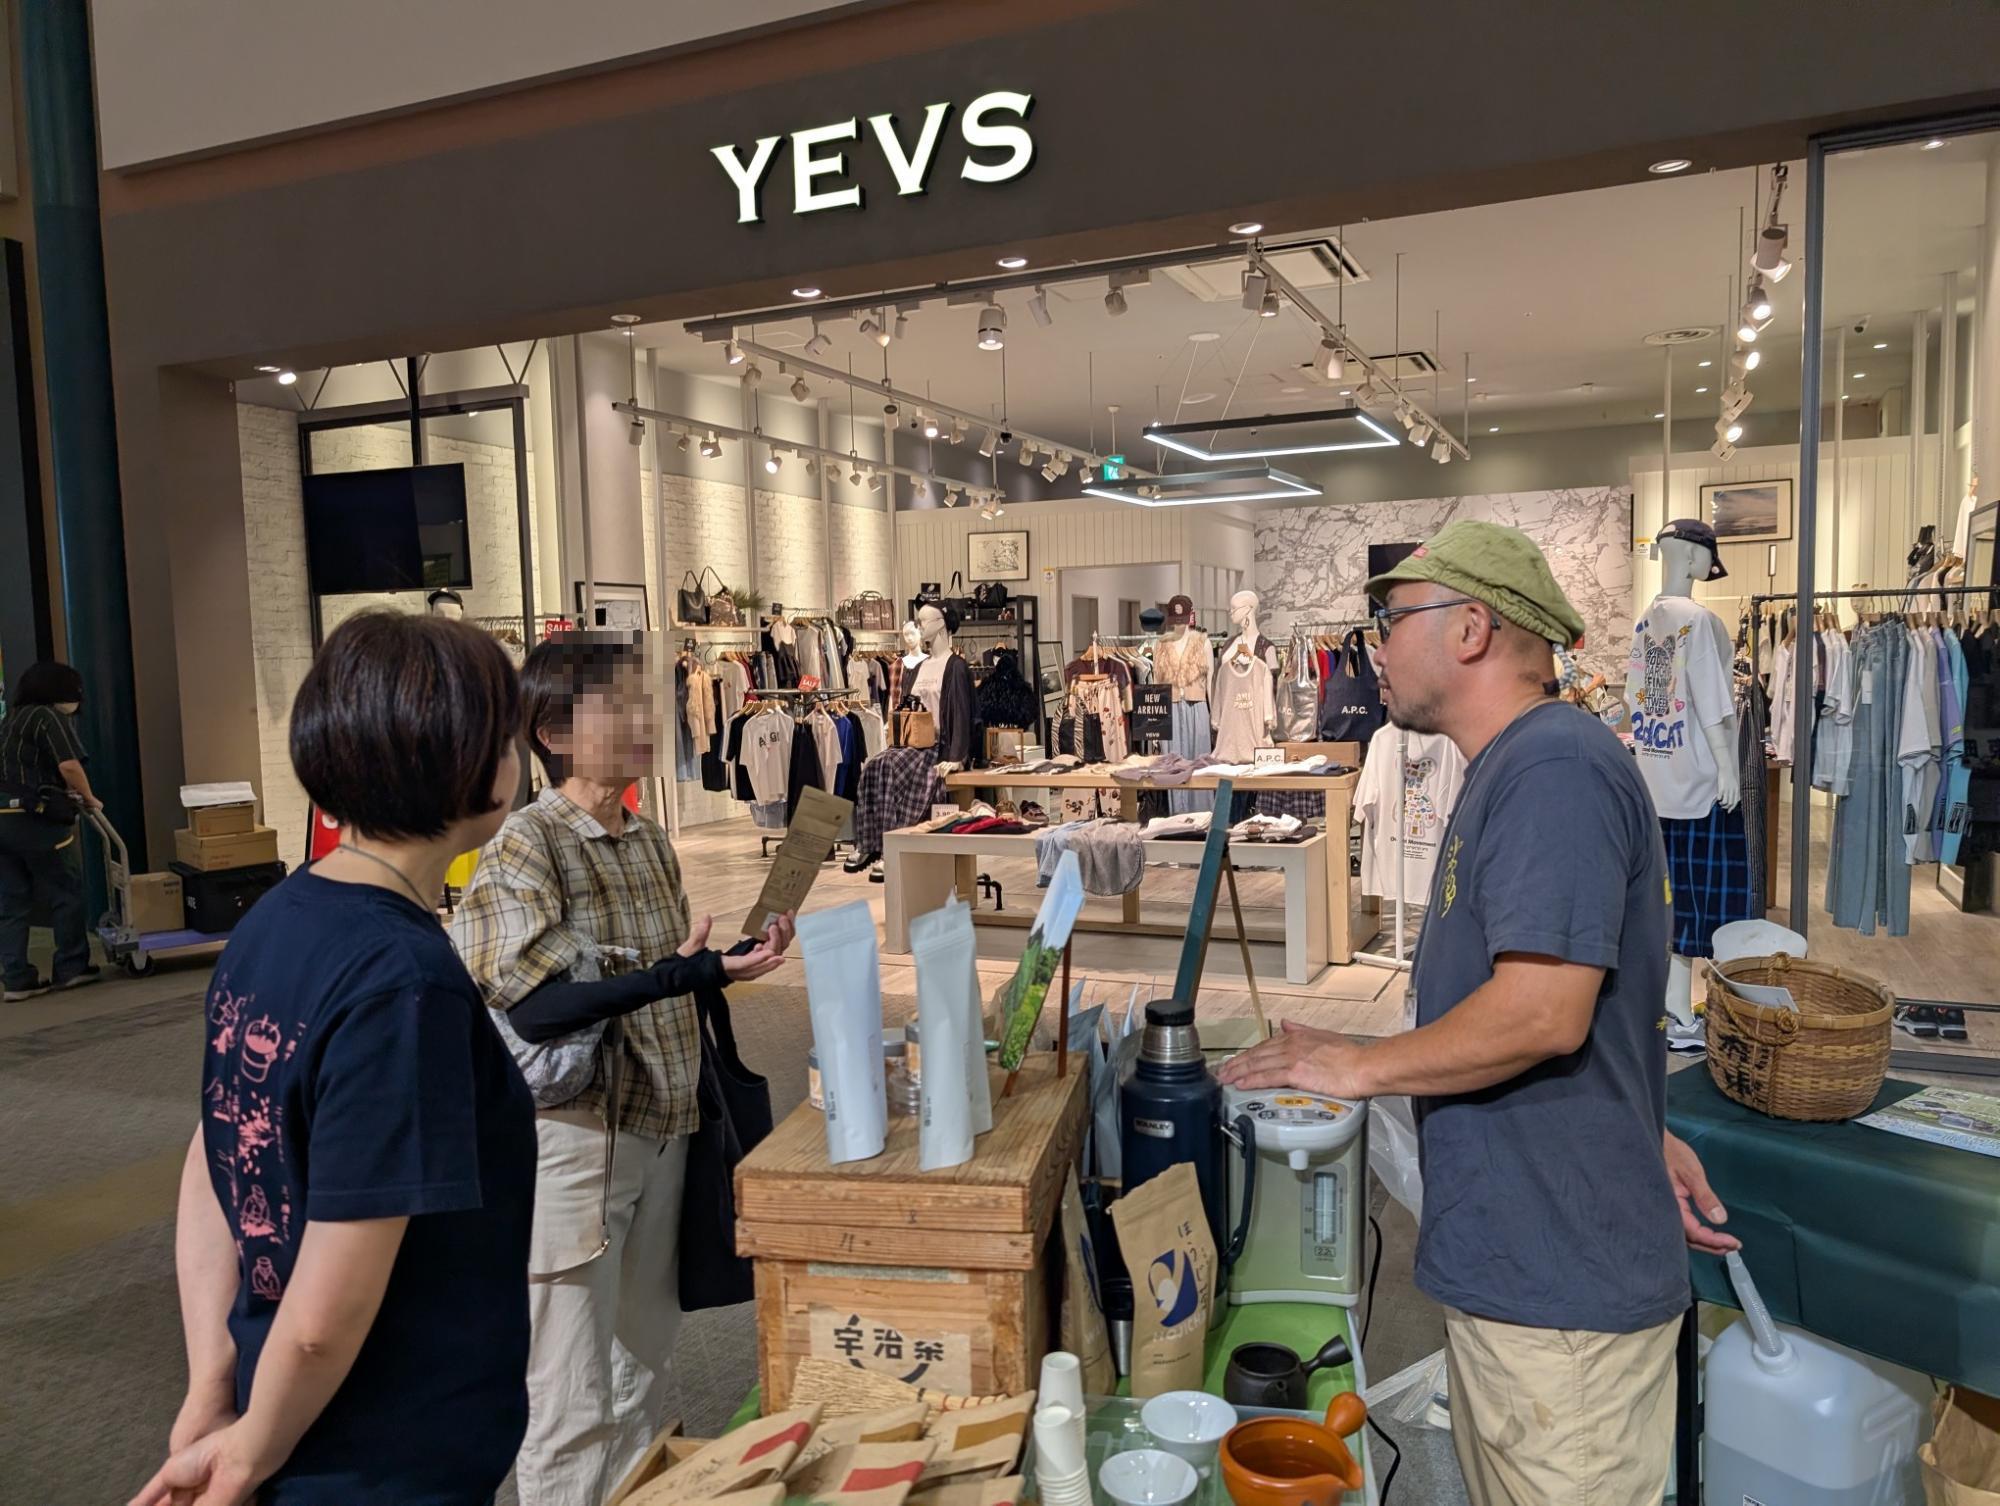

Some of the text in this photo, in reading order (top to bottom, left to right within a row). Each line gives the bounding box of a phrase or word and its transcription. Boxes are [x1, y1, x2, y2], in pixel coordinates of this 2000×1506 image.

[709, 90, 1034, 224] YEVS
[1144, 693, 1161, 703] NEW
[1137, 704, 1168, 715] ARRIVAL
[1341, 705, 1368, 715] A.P.C.
[1255, 754, 1284, 763] A.P.C.
[833, 1326, 944, 1362] 宇治茶
